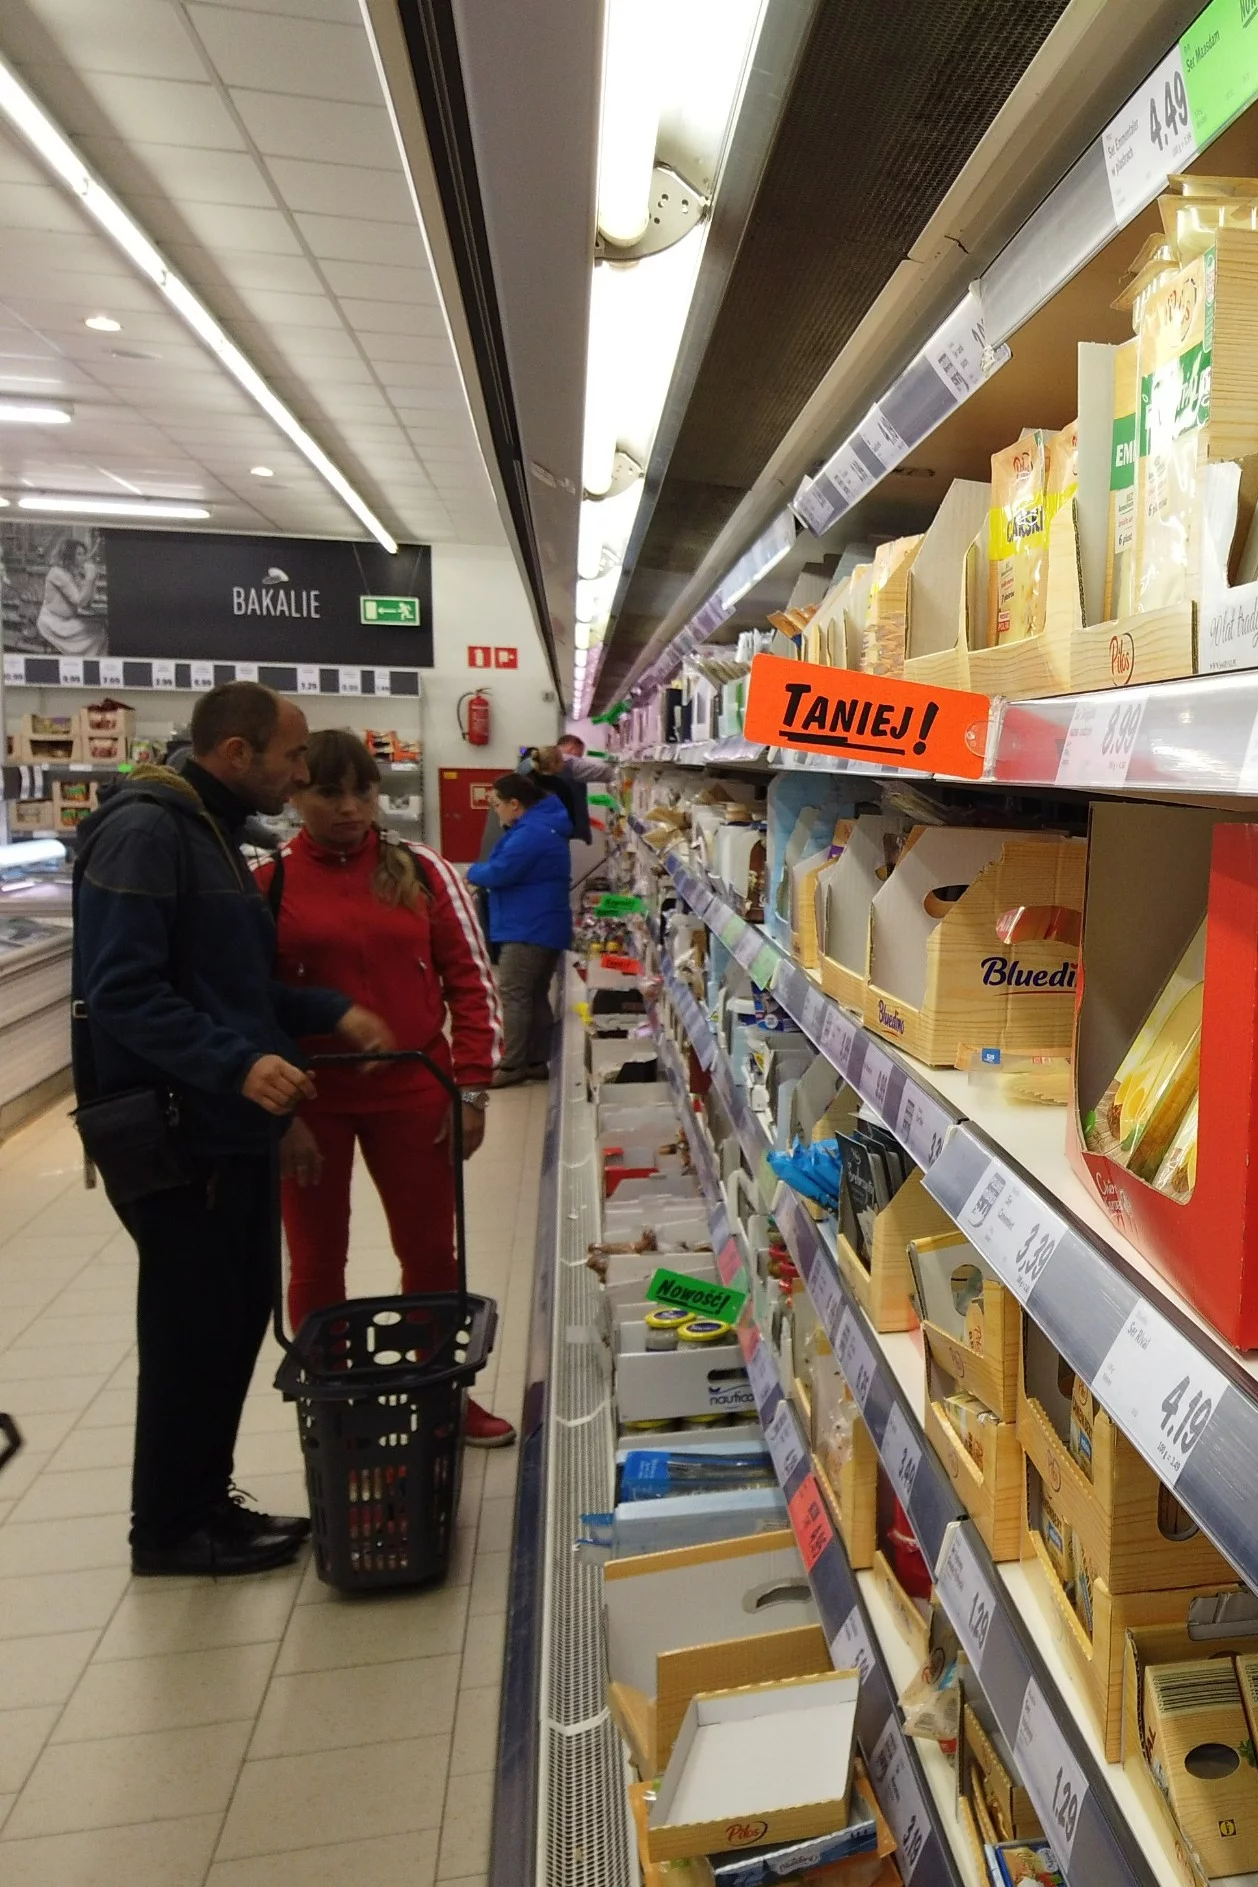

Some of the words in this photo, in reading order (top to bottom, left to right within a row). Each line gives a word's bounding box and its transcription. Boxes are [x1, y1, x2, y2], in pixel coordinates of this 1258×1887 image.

[1150, 71, 1189, 151] 4.49
[233, 586, 320, 619] BAKALIE
[1109, 633, 1131, 677] Pilos
[783, 683, 940, 756] TANIEJ!
[1102, 703, 1142, 756] 8.99
[1015, 1223, 1056, 1281] 3.39
[1160, 1375, 1212, 1454] 4.19
[968, 1592, 990, 1651] 1.29
[725, 1821, 761, 1845] Pilos
[1051, 1766, 1078, 1844] 1.29
